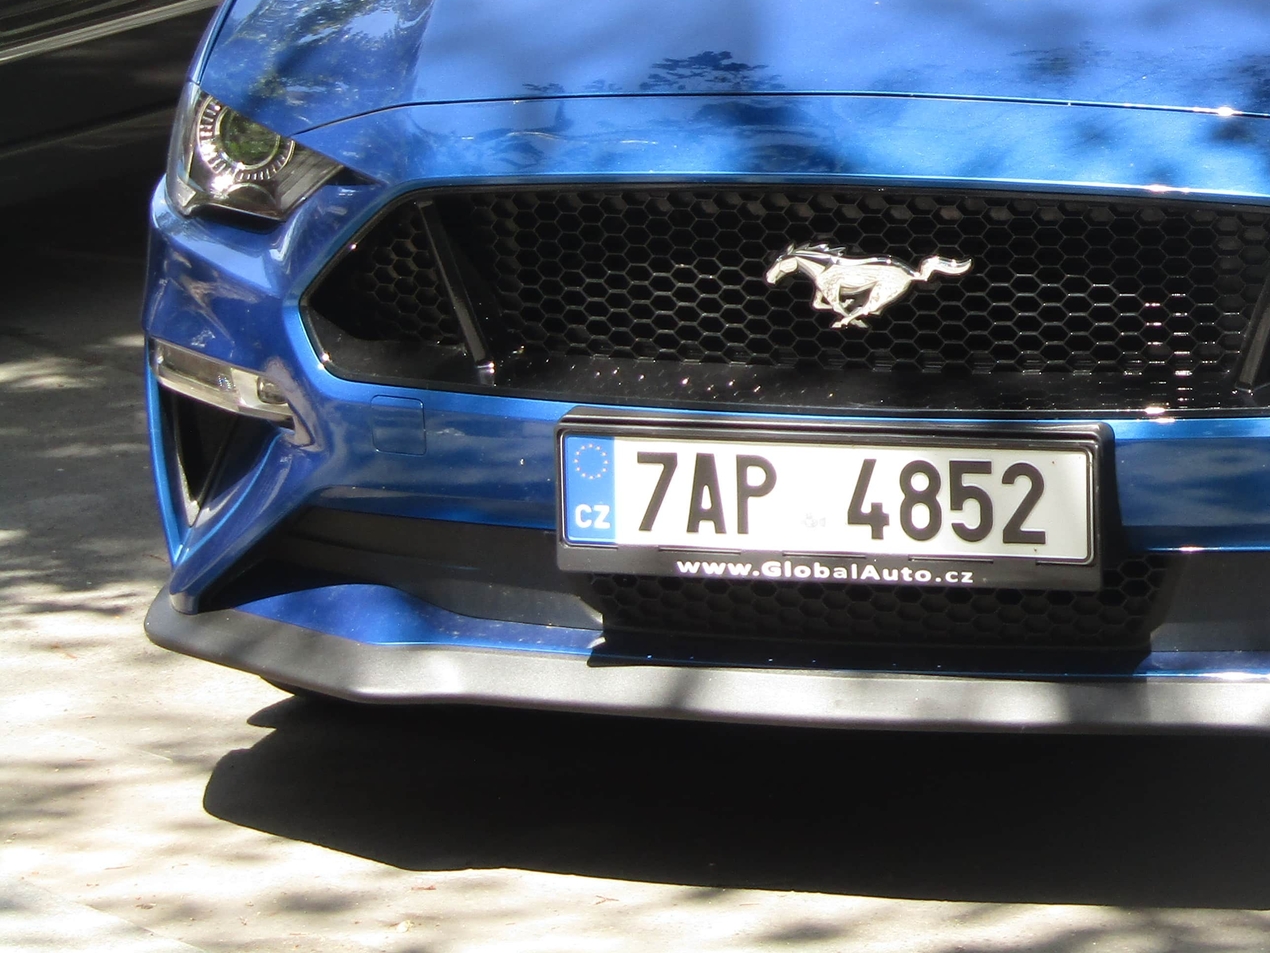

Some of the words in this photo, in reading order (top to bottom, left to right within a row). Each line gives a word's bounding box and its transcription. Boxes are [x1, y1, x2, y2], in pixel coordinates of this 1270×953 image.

[636, 451, 777, 535] 7AP
[847, 458, 1046, 545] 4852
[575, 505, 610, 529] CZ
[677, 559, 974, 585] www.GlobalAuto.cz
